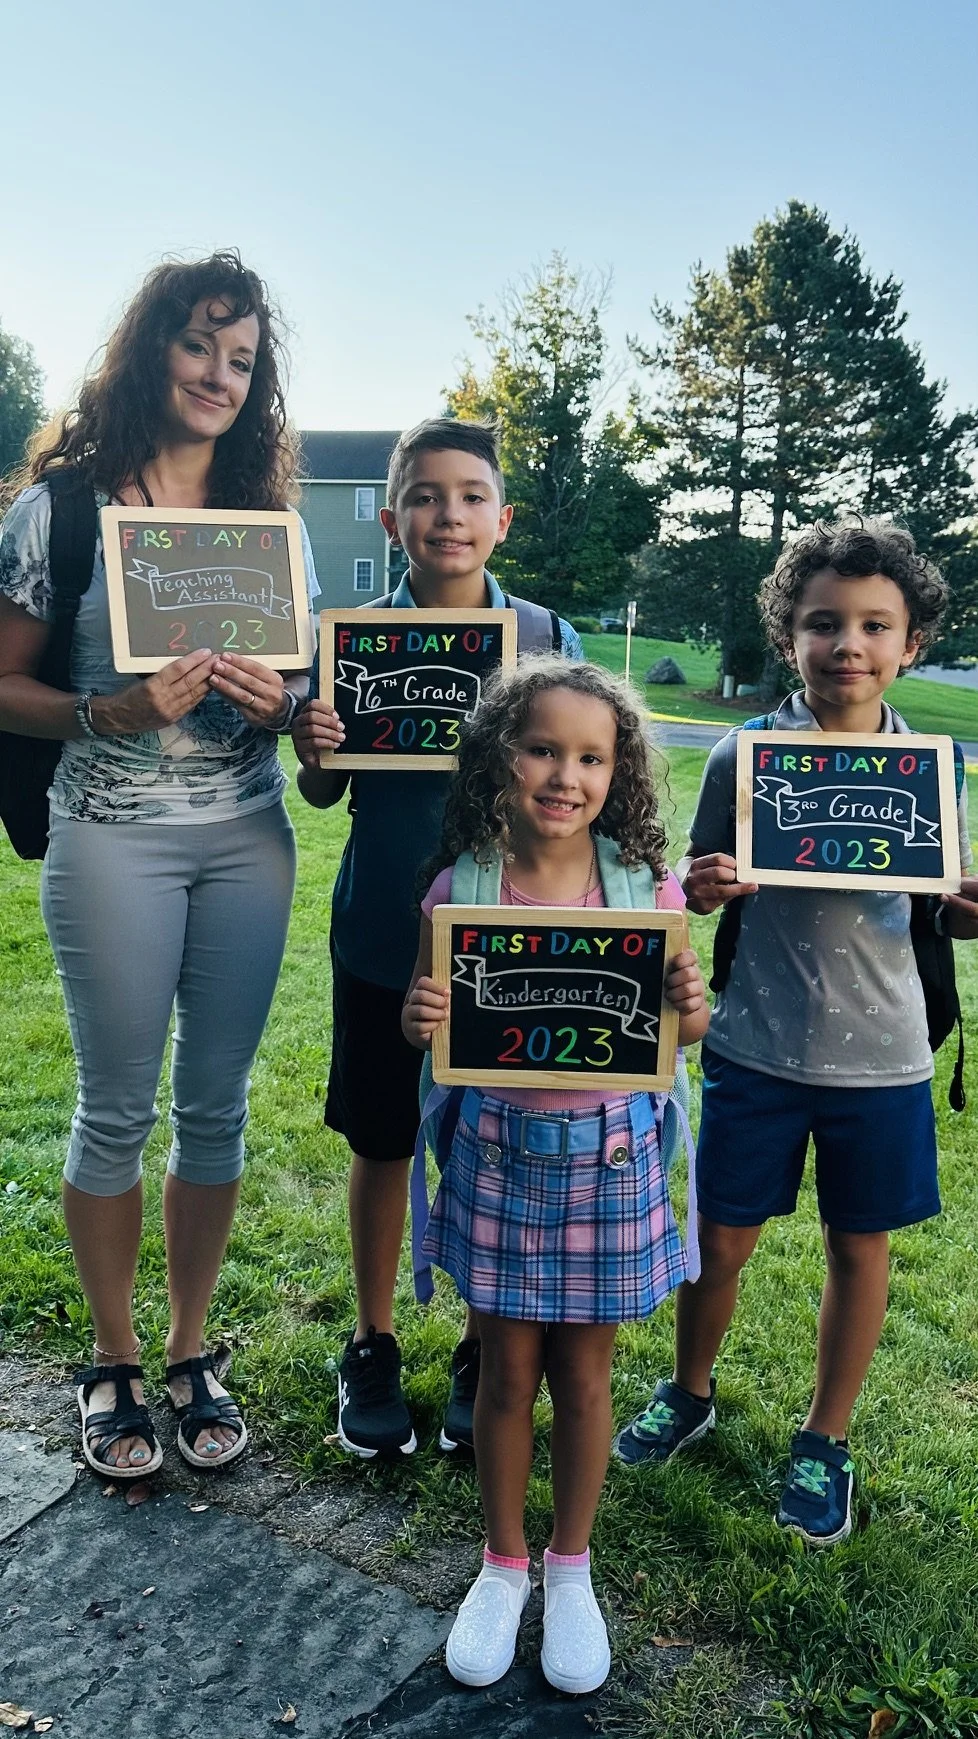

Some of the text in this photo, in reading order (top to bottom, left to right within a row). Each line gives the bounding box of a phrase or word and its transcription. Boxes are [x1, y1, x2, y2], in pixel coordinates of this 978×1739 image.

[152, 572, 234, 593] Teaching
[177, 588, 268, 604] Assistant
[168, 619, 267, 650] 2023
[338, 628, 494, 653] FIRST DAY OF
[403, 676, 468, 702] Grade
[371, 717, 463, 750] 2023
[759, 750, 932, 776] FIRST DAY OF
[828, 793, 908, 824] Grade
[795, 837, 892, 870] 2023
[462, 930, 660, 957] FIRST DAY OF
[481, 978, 631, 1011] Kindergarten
[497, 1026, 614, 1067] 2023
